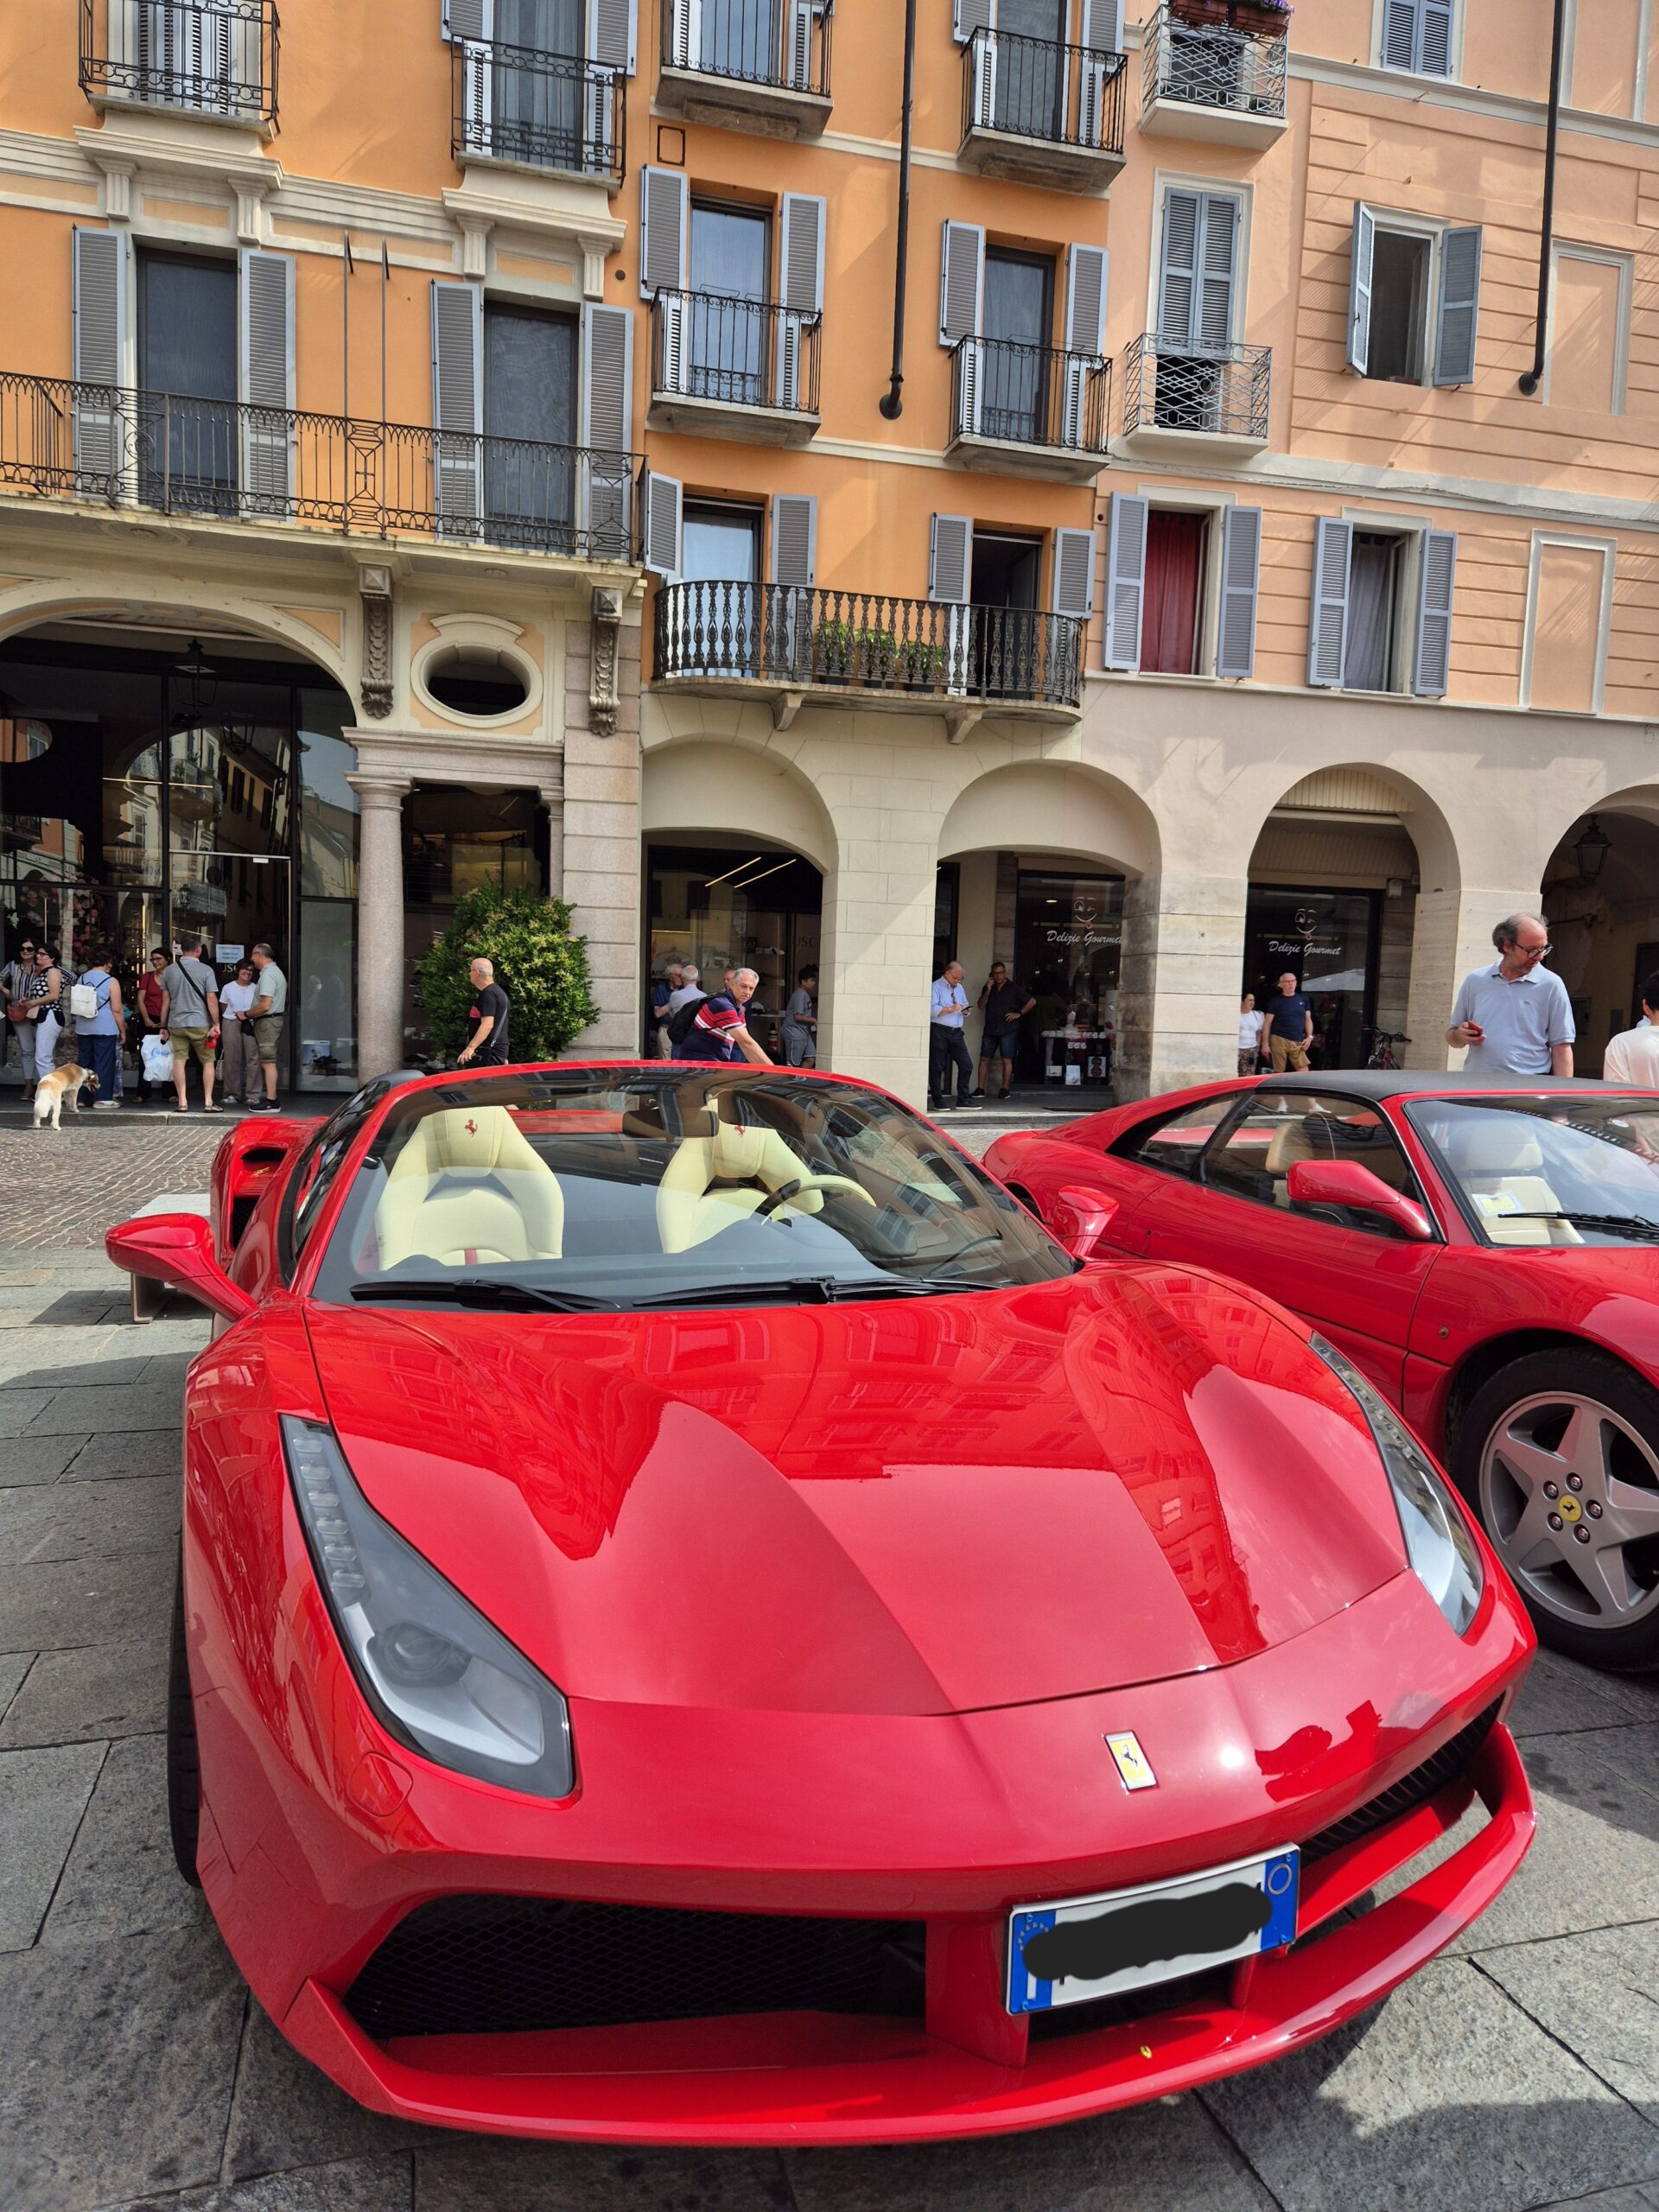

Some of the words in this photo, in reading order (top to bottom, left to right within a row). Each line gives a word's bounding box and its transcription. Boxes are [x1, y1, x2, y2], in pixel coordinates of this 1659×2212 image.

[1046, 930, 1080, 946] Delizie
[1268, 941, 1301, 956] Delizie
[1303, 943, 1342, 957] Gourmet
